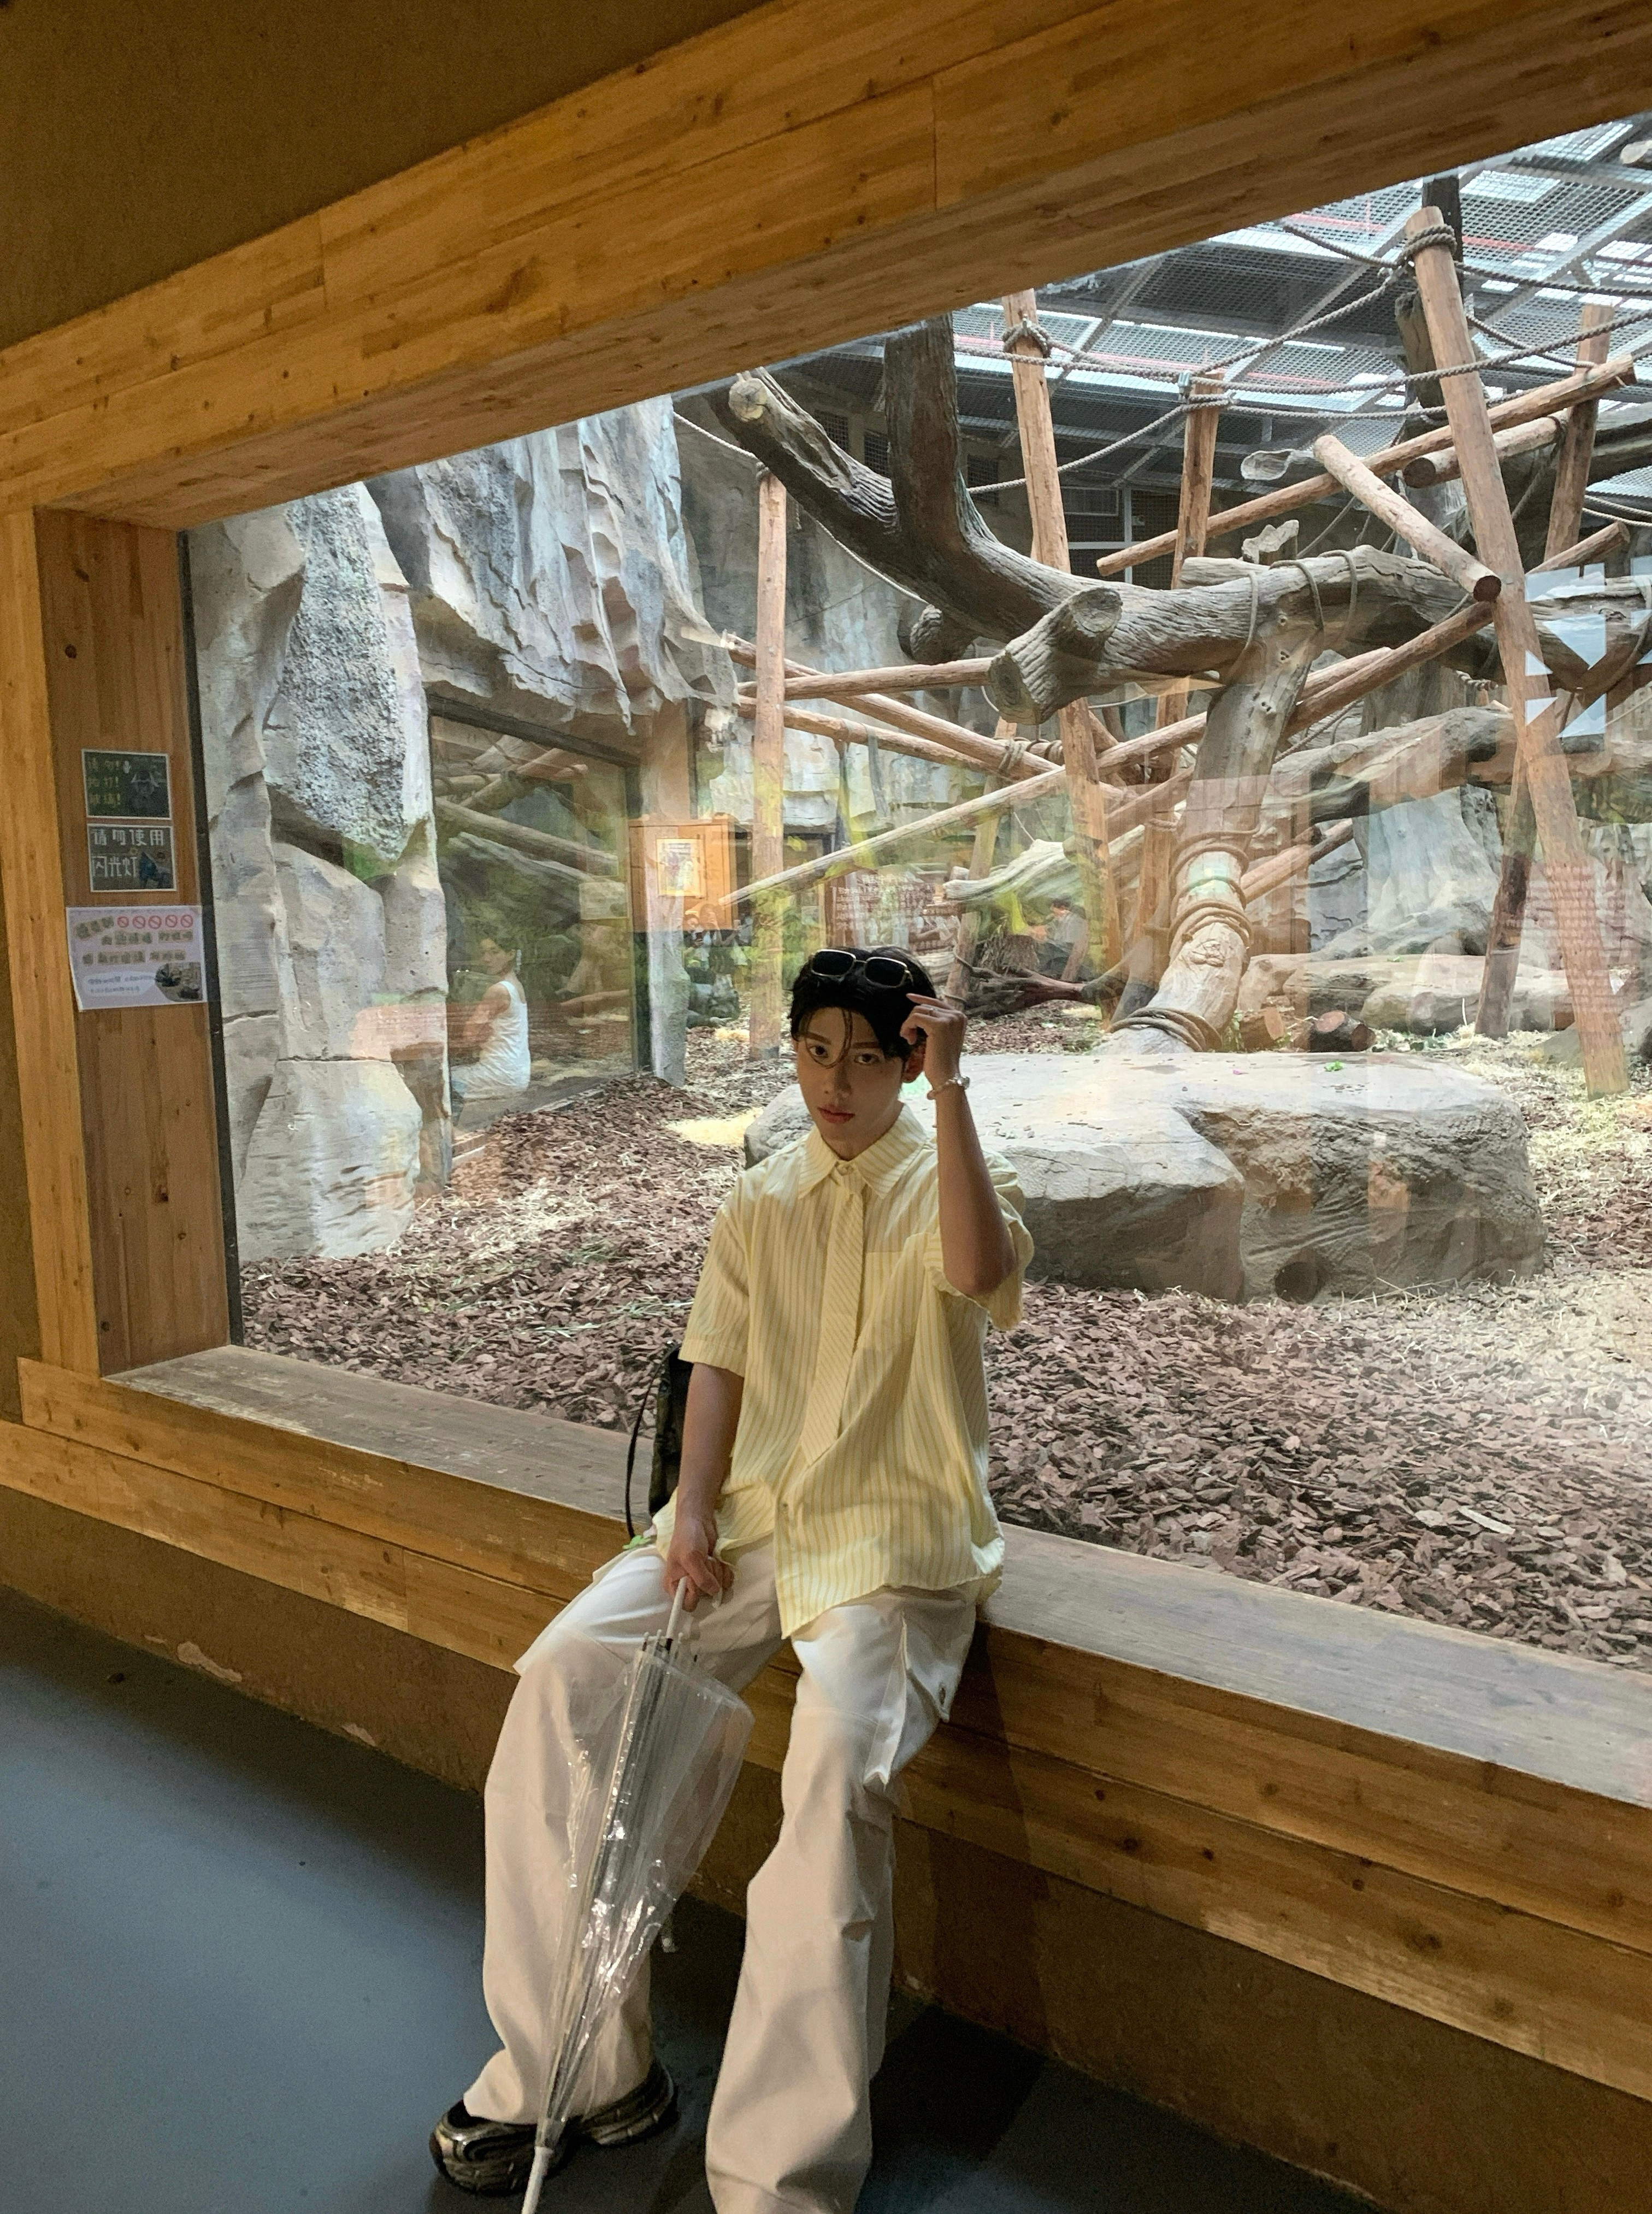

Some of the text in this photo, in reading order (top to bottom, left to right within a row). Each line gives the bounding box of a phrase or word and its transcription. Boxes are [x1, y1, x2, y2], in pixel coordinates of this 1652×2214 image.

[91, 829, 163, 846] 请勿使用
[92, 856, 138, 877] 闪光灯
